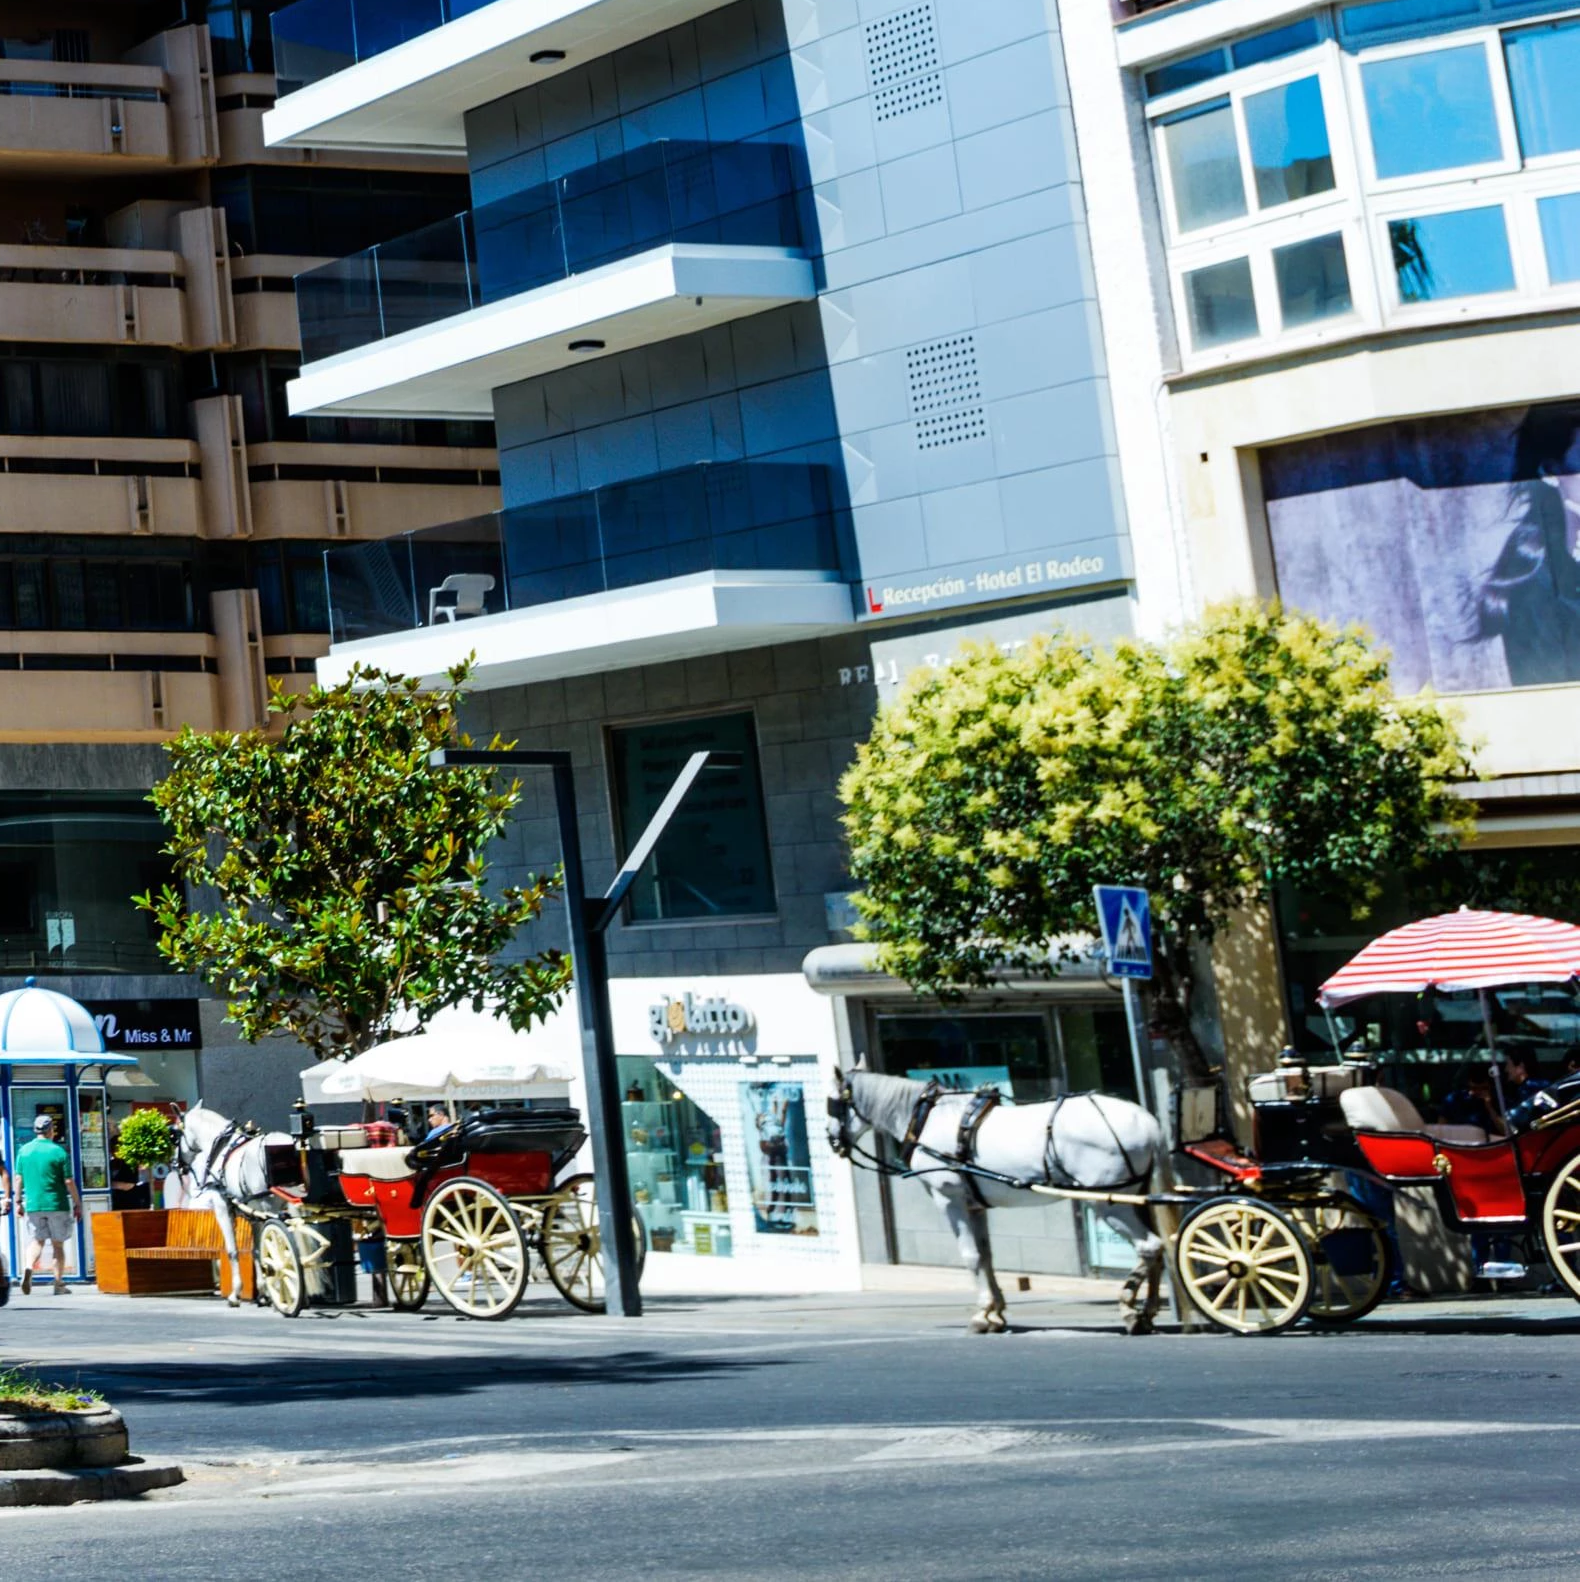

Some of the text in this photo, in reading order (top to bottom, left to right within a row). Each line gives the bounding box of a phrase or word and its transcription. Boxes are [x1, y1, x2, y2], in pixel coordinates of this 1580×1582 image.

[883, 575, 966, 606] Recepción
[975, 566, 1023, 592] Hotel
[1026, 561, 1043, 585] El
[1046, 556, 1104, 581] Rodeo
[125, 1028, 192, 1043] Miss & Mr
